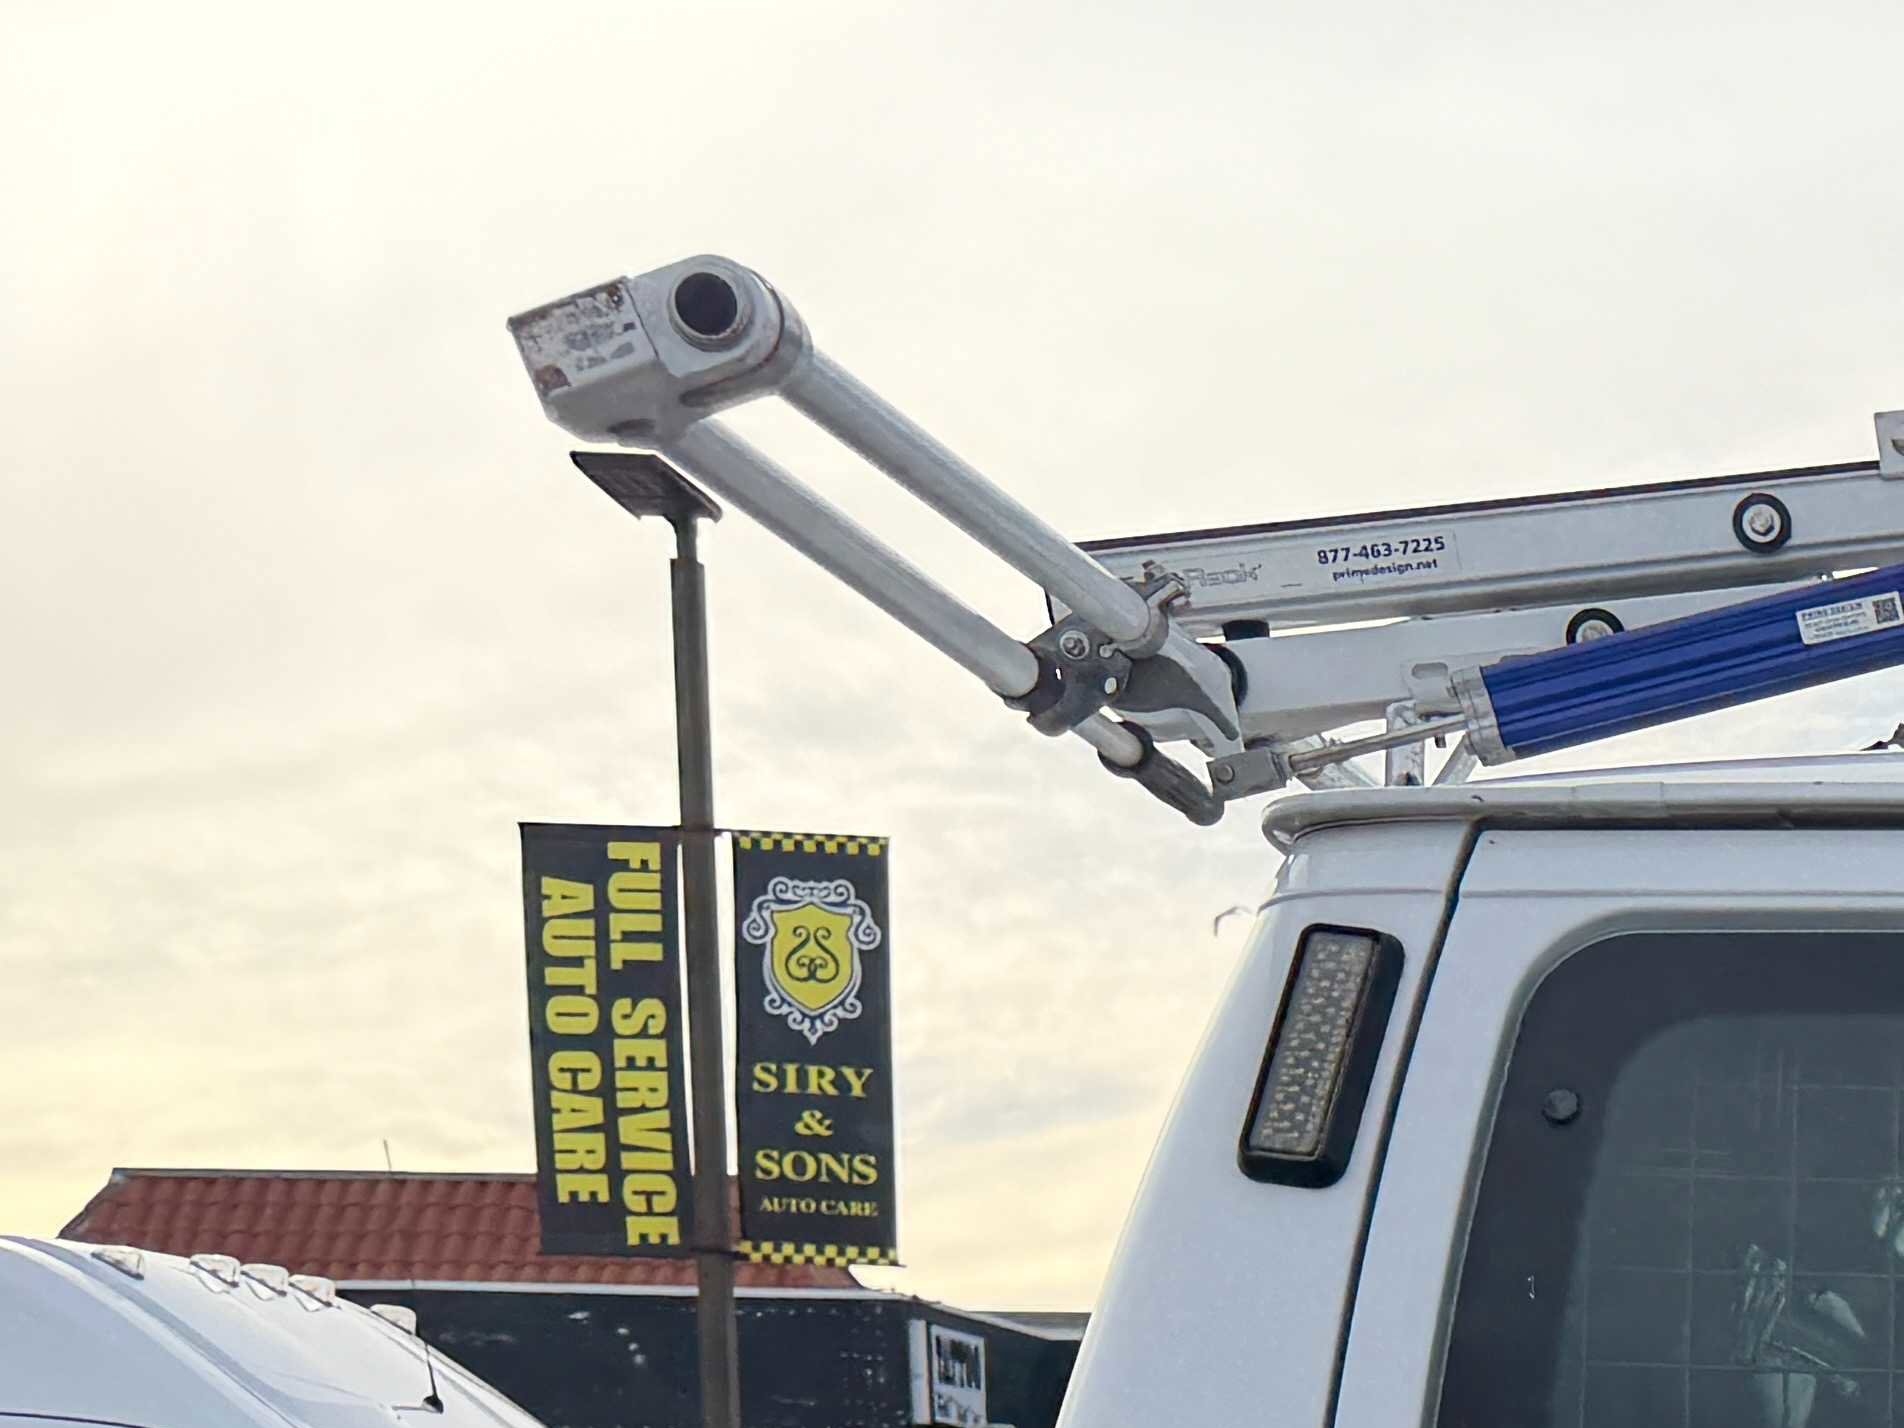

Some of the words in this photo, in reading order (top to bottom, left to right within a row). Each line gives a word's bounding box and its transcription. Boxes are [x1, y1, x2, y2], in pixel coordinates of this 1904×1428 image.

[1317, 536, 1445, 565] 877-463-7225
[606, 840, 664, 970] FULL
[540, 876, 600, 1035] AUTO
[752, 1062, 875, 1099] SIRY
[546, 1050, 611, 1205] CARE
[610, 996, 682, 1248] SERVICE
[794, 1109, 834, 1137] &
[754, 1151, 879, 1186] SONS
[759, 1197, 817, 1214] AUTO
[820, 1198, 879, 1217] CARE
